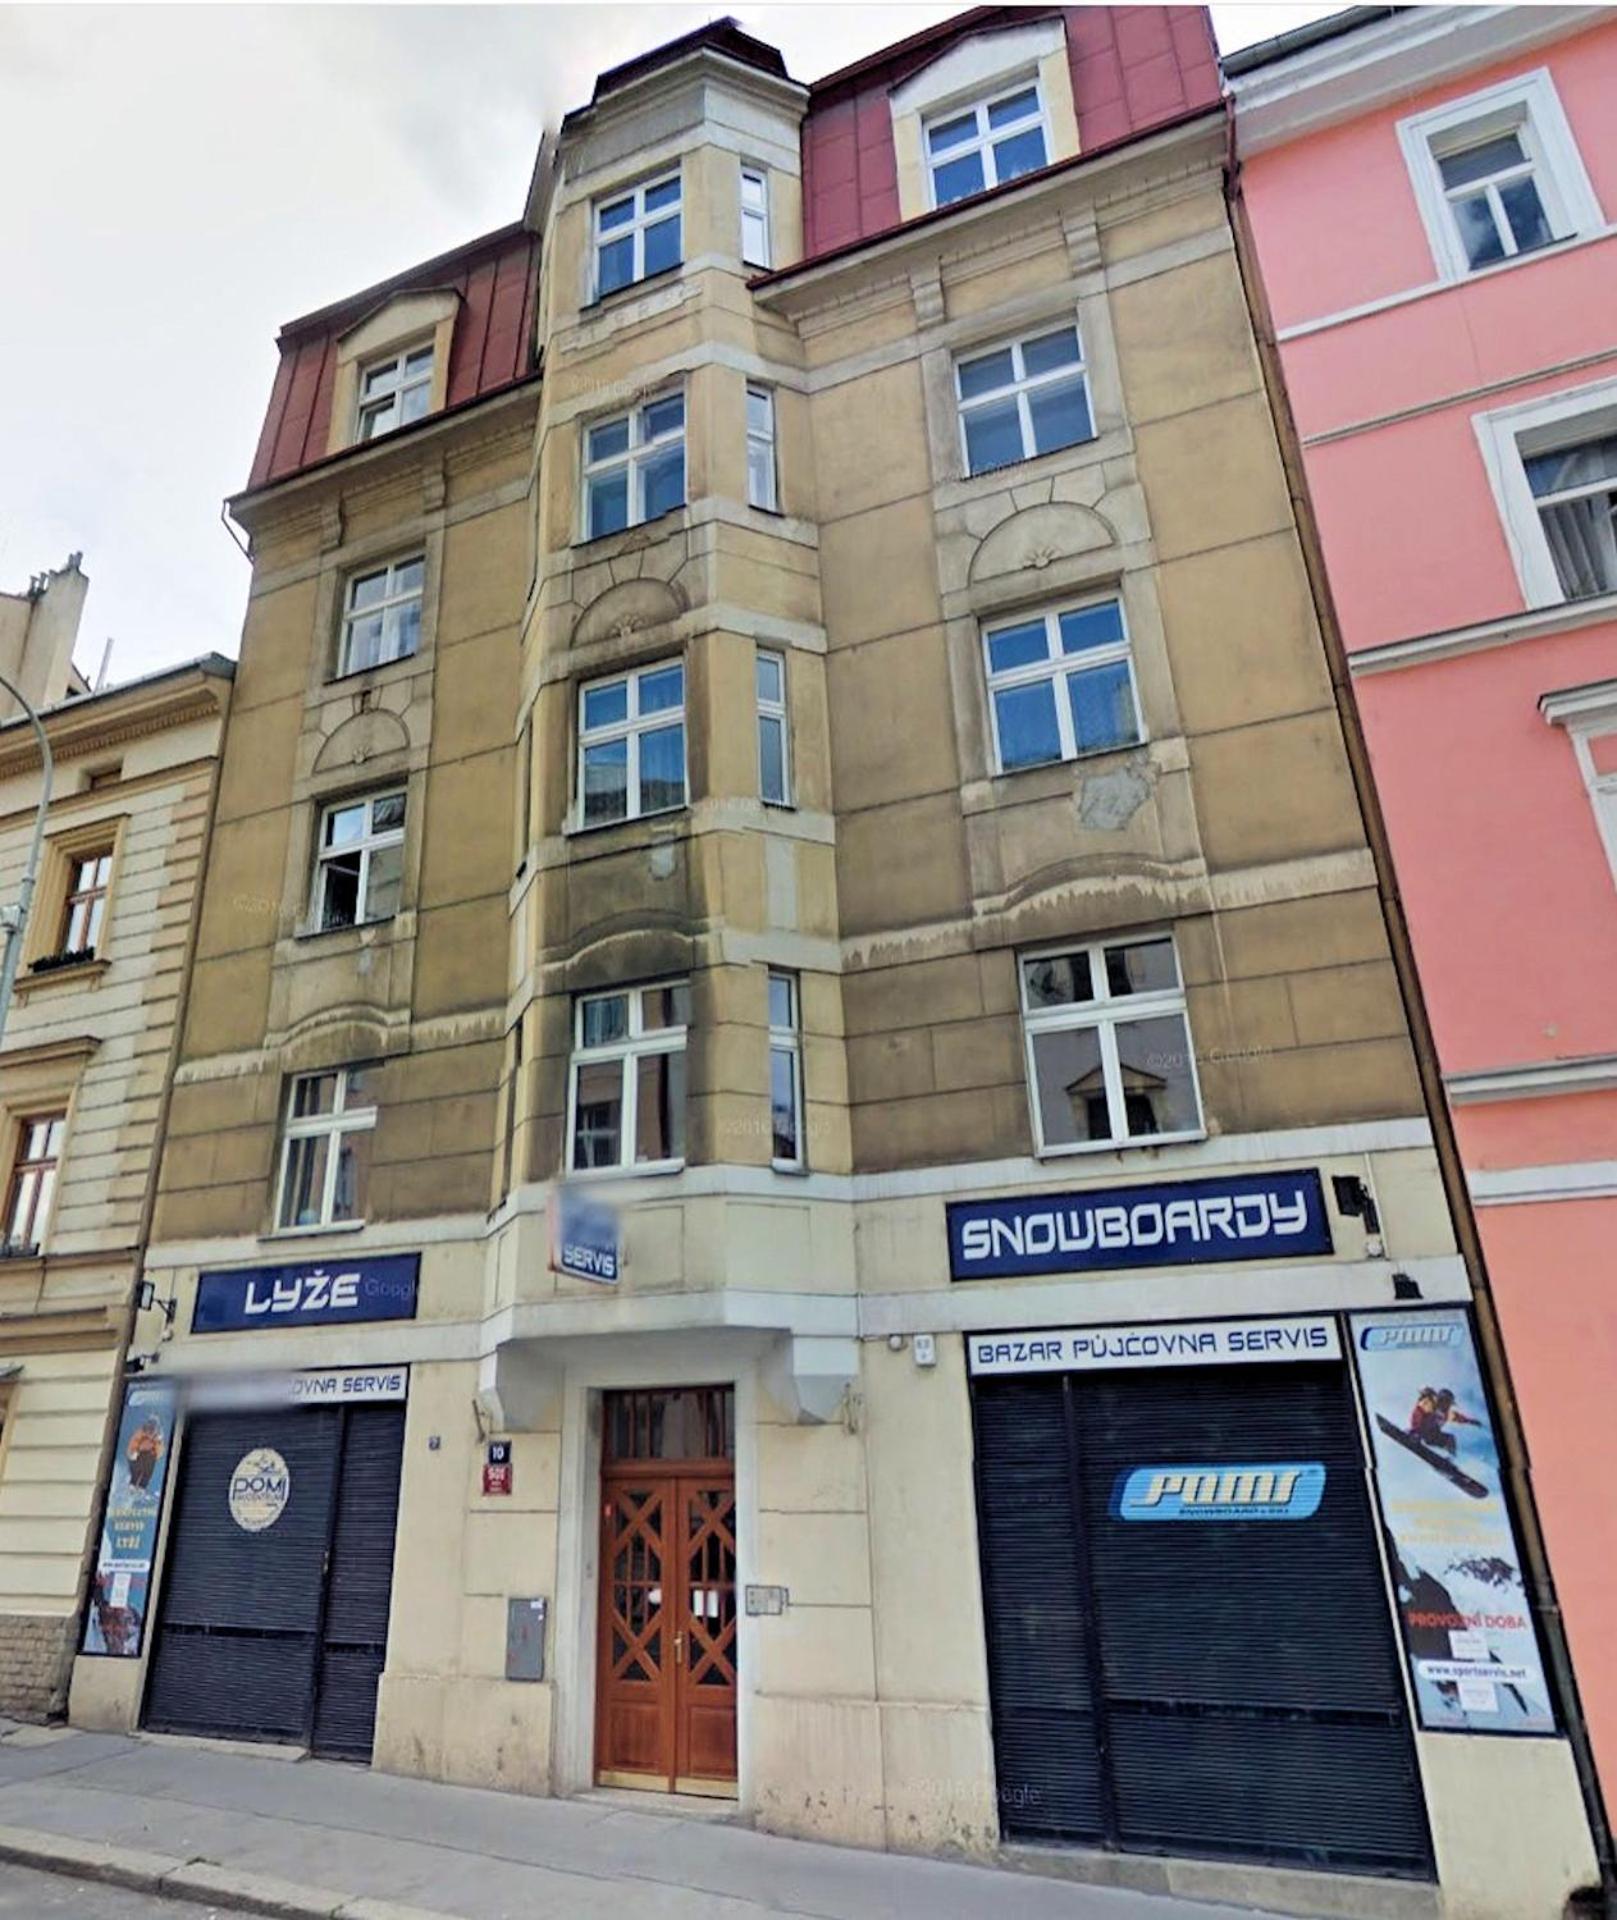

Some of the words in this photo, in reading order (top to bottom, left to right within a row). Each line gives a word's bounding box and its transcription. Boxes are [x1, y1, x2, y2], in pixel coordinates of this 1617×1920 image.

[962, 1190, 1308, 1261] SNOWBOARDY
[563, 1242, 615, 1277] SERVIS
[244, 1269, 361, 1315] LYŽE
[978, 1340, 1063, 1364] BAZAR
[1227, 1326, 1328, 1352] SERVIS
[342, 1374, 402, 1393] SERVIS
[492, 1445, 505, 1460] 10
[1485, 1612, 1527, 1630] DOBA
